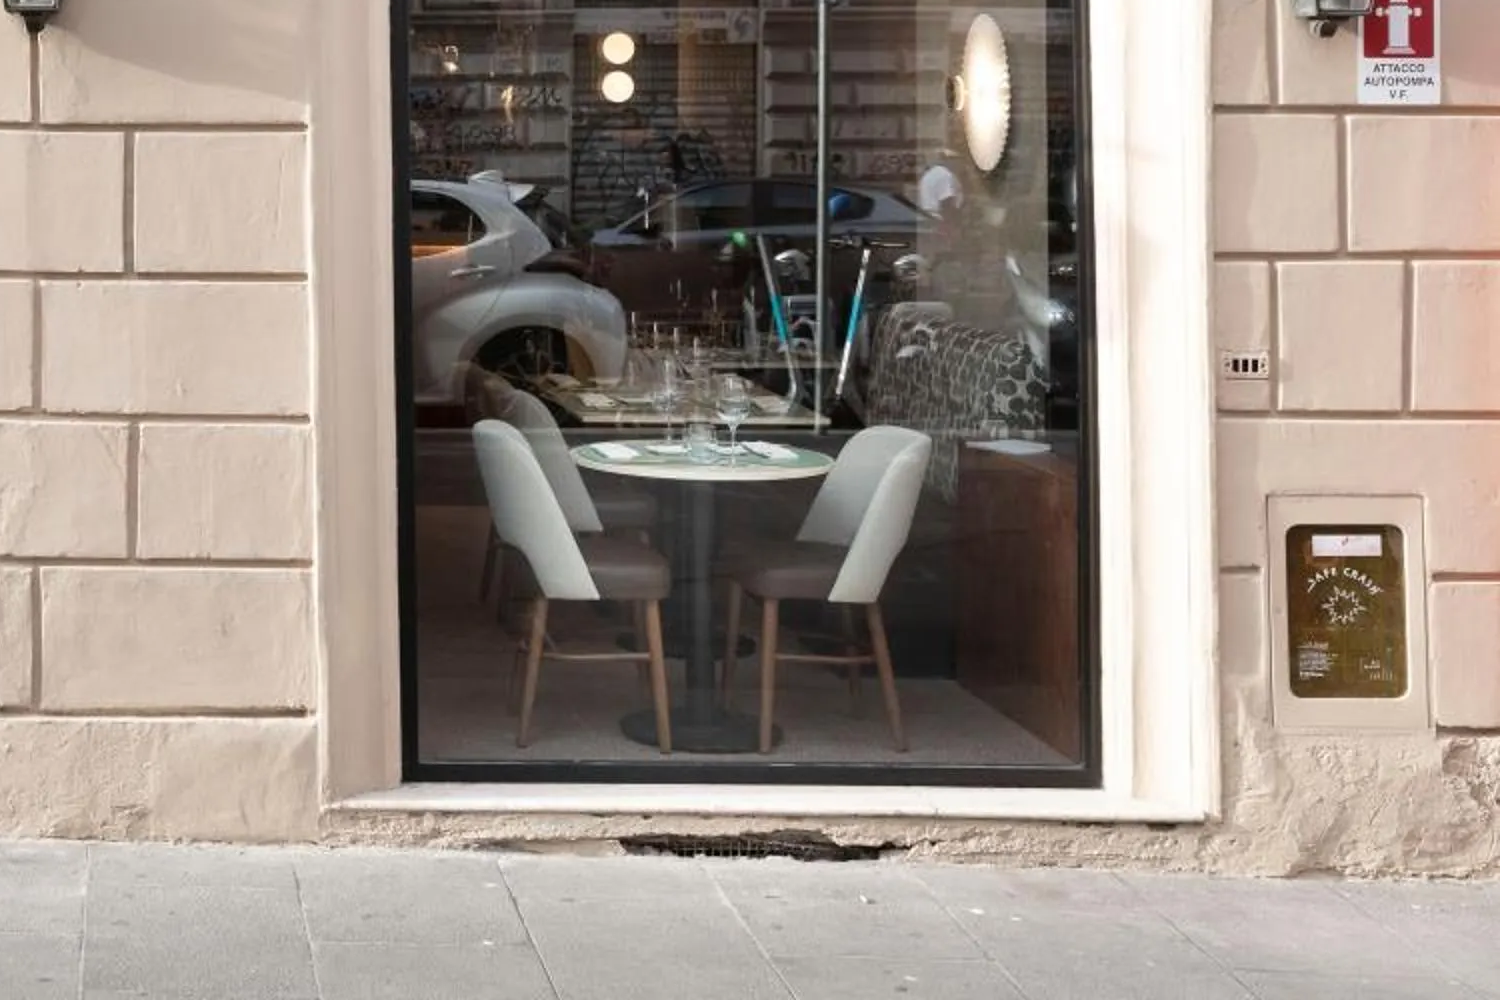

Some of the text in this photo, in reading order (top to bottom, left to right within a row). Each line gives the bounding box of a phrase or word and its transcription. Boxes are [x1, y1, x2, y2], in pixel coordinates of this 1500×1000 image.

[1373, 63, 1425, 73] ATTACCO
[1364, 77, 1435, 87] AUTOPOMPA
[1389, 89, 1409, 99] V.F.
